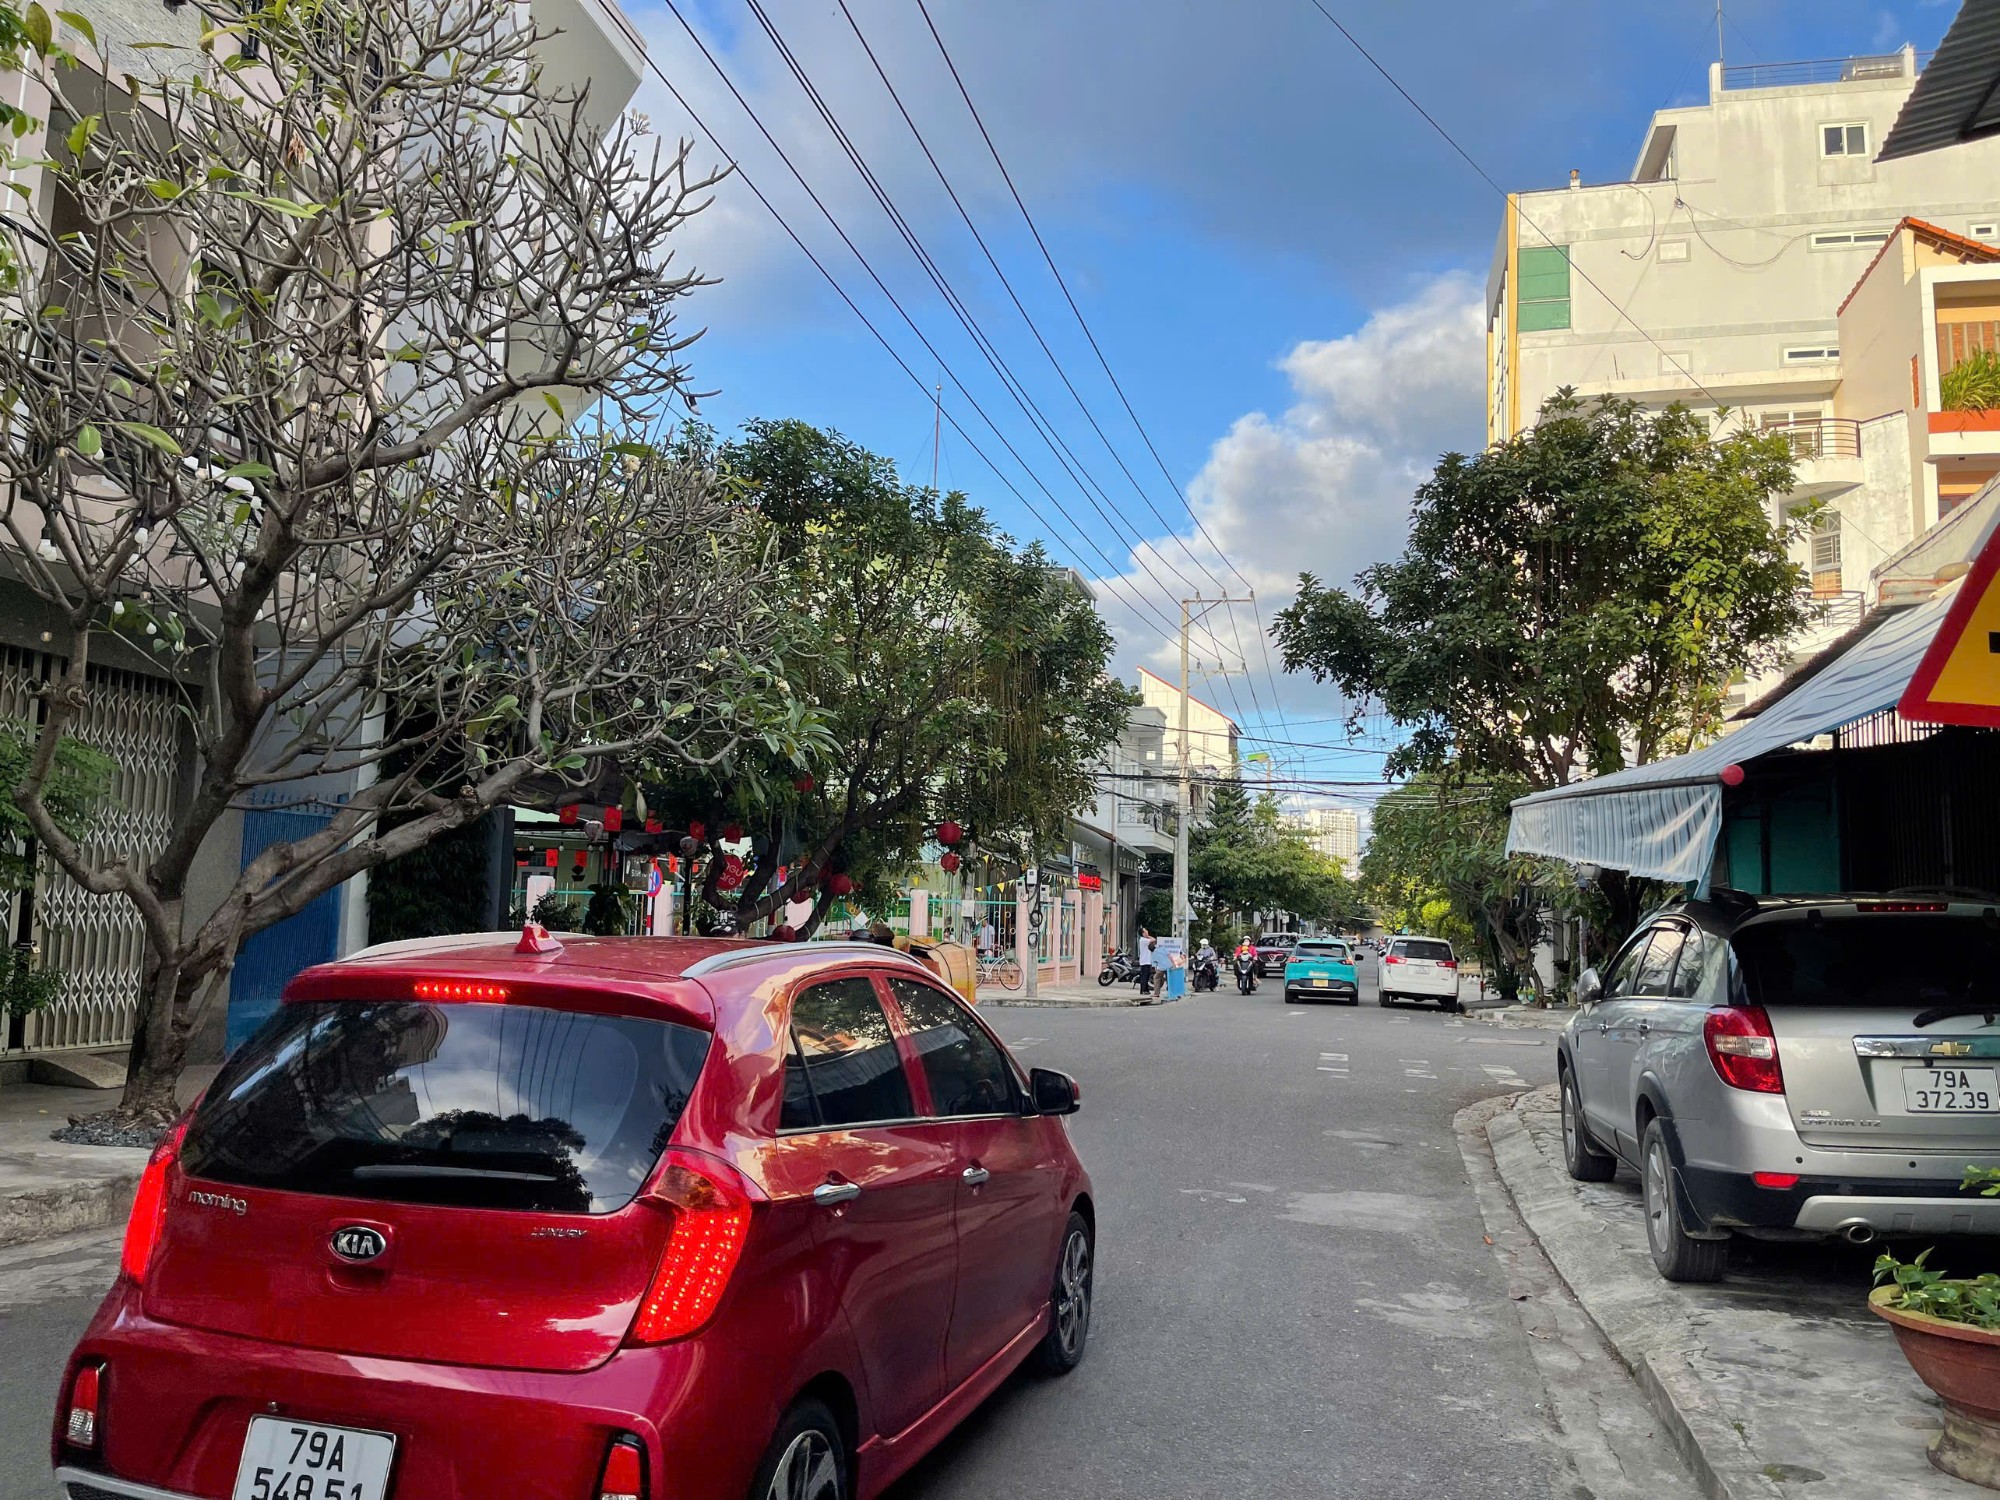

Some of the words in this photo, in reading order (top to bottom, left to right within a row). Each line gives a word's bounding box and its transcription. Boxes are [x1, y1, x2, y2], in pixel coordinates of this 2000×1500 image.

[719, 872, 736, 886] afe
[1929, 1070, 1971, 1089] 79A
[1915, 1090, 1990, 1109] 372.39
[1800, 1118, 1855, 1127] CAPTIVA
[1859, 1119, 1882, 1128] LTZ
[188, 1190, 248, 1216] morning
[337, 1232, 376, 1256] KIA
[288, 1427, 345, 1473] 79A
